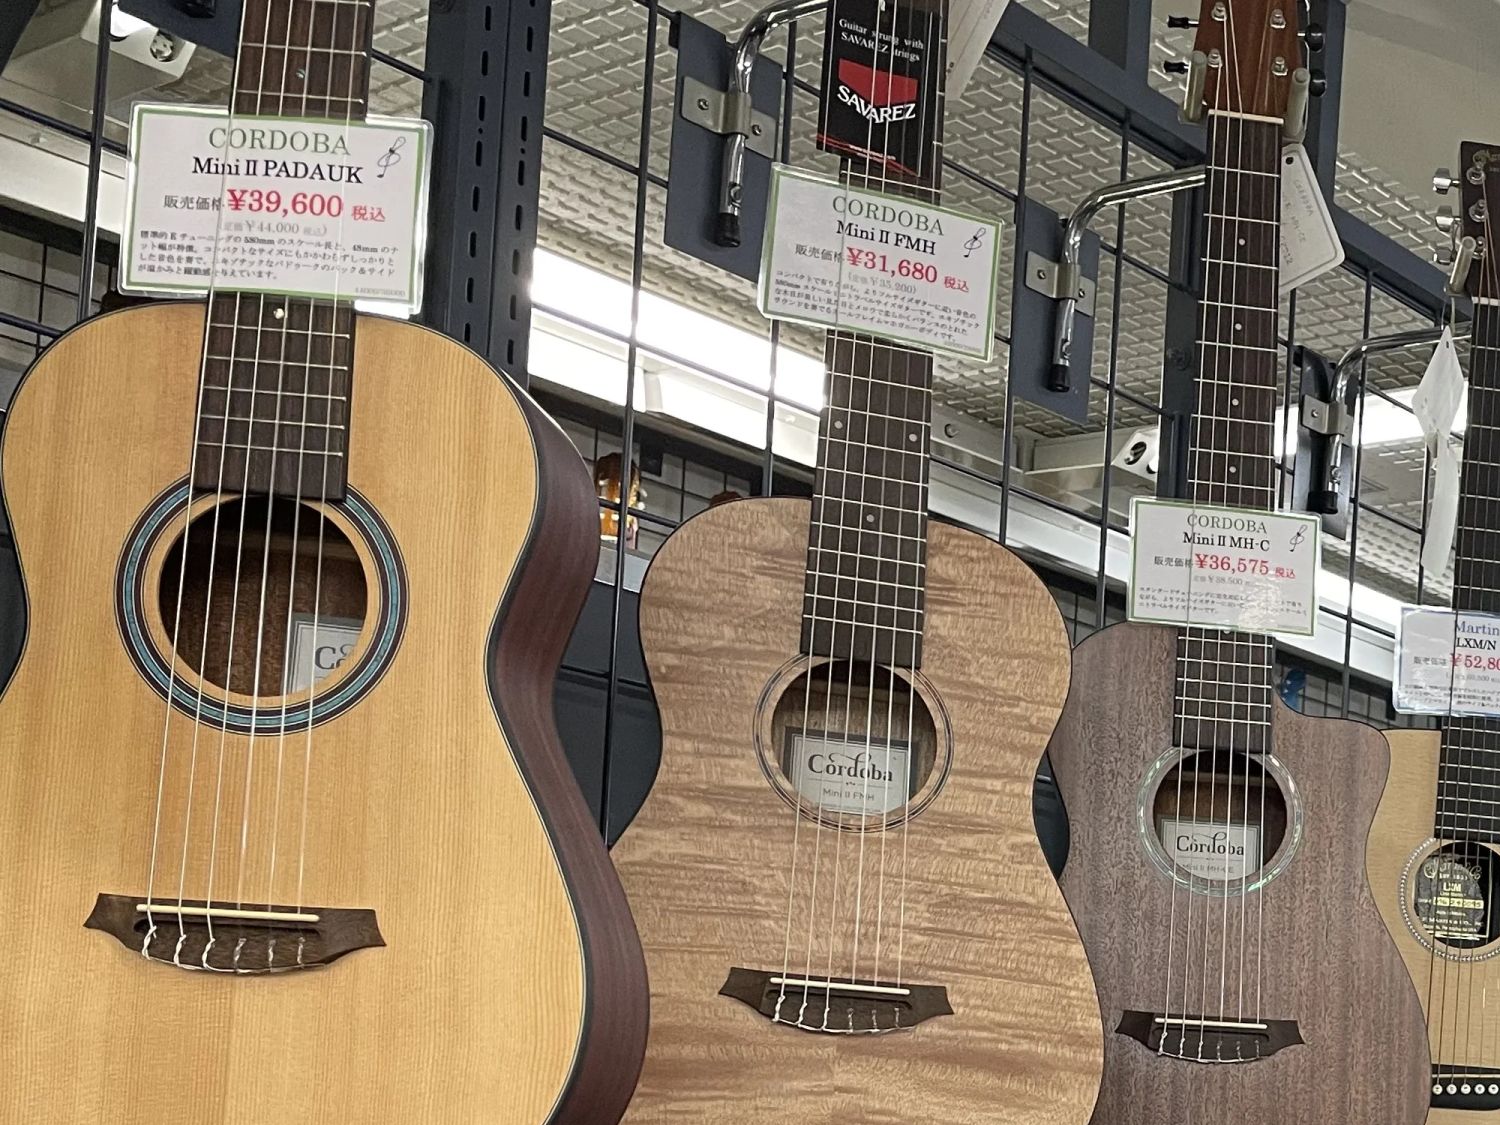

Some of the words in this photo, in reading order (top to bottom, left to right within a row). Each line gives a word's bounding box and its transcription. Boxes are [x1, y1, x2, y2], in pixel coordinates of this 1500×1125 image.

[839, 18, 867, 34] Guitar
[871, 30, 900, 44] srung
[904, 37, 924, 50] with
[841, 32, 889, 53] SAVAREZ
[892, 49, 920, 62] trings
[837, 85, 916, 124] SAVAREZ
[209, 127, 350, 155] CORDOBA
[192, 156, 239, 176] Mini
[264, 160, 363, 184] PADAUK
[163, 194, 224, 212] 販売価格
[228, 188, 344, 218] ¥39,600
[351, 205, 386, 222] 税込
[832, 195, 944, 236] CORDOBA
[836, 220, 874, 242] Mini
[894, 232, 936, 256] FMH
[794, 243, 844, 262] 販売価格
[846, 246, 938, 283] ¥31,680
[944, 276, 970, 294] 税込
[1187, 513, 1267, 534] CORDOBA
[1183, 532, 1214, 546] Mini
[1230, 536, 1270, 552] MH-C
[1154, 556, 1194, 568] 販売価格
[1194, 553, 1269, 576] ¥36,575
[1274, 566, 1296, 579] 税込
[1456, 620, 1500, 636] Martin
[1456, 637, 1497, 650] LXM/N
